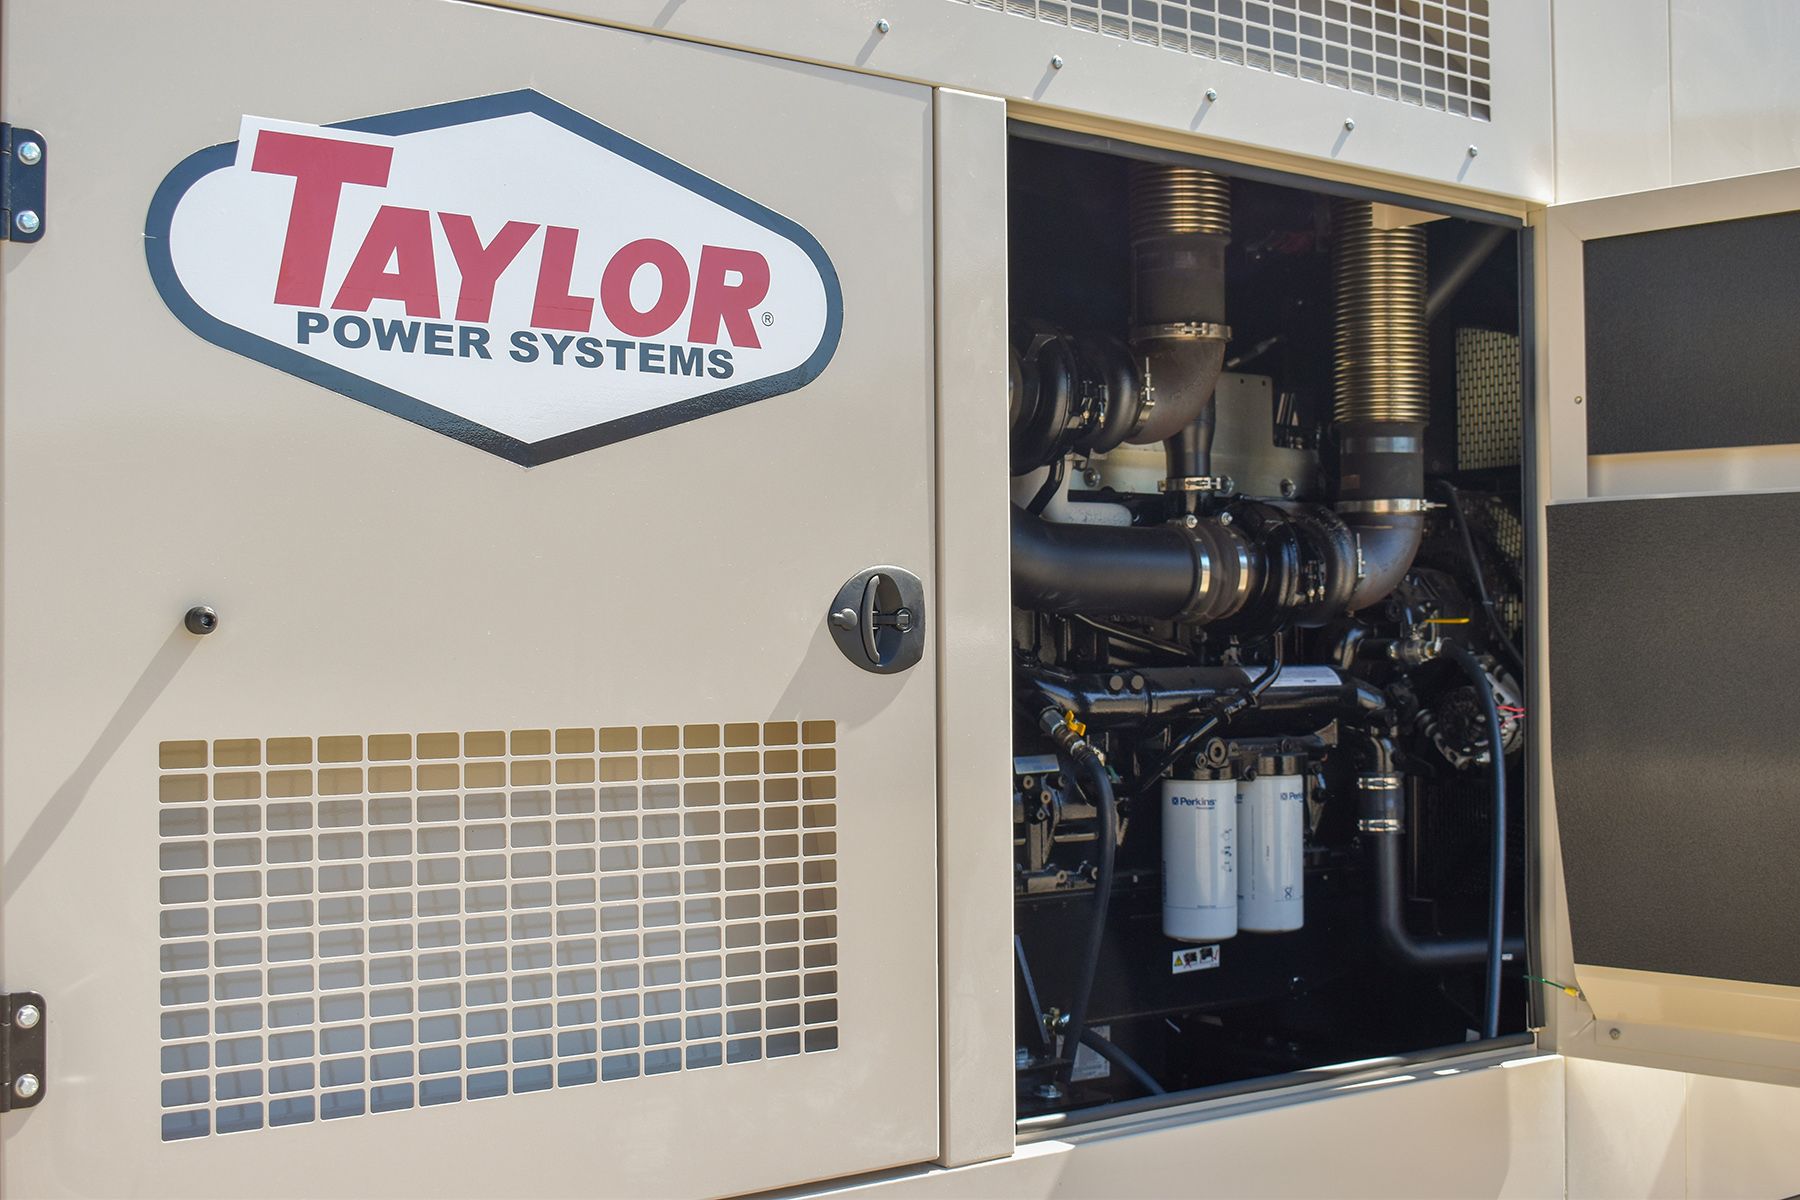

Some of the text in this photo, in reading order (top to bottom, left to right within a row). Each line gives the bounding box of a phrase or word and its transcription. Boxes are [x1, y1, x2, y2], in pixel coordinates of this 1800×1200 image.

[251, 129, 771, 349] TAYLOR
[297, 311, 735, 379] POWER SYSTEMS
[1179, 796, 1216, 806] Perkins
